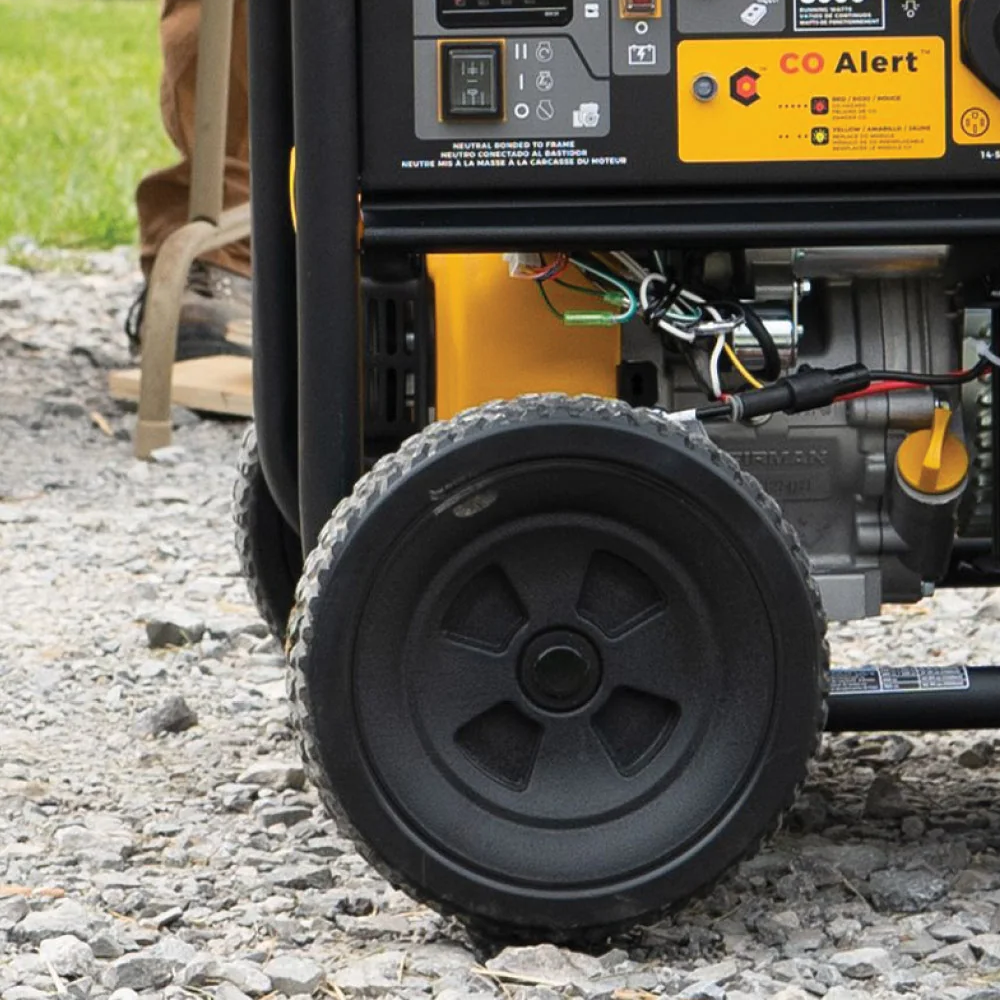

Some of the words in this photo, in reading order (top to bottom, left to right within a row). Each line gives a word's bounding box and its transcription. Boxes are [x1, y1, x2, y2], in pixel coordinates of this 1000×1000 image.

[779, 52, 825, 74] CO
[835, 51, 917, 73] Alert
[546, 140, 575, 148] FRAME
[440, 150, 475, 158] NEUTRO
